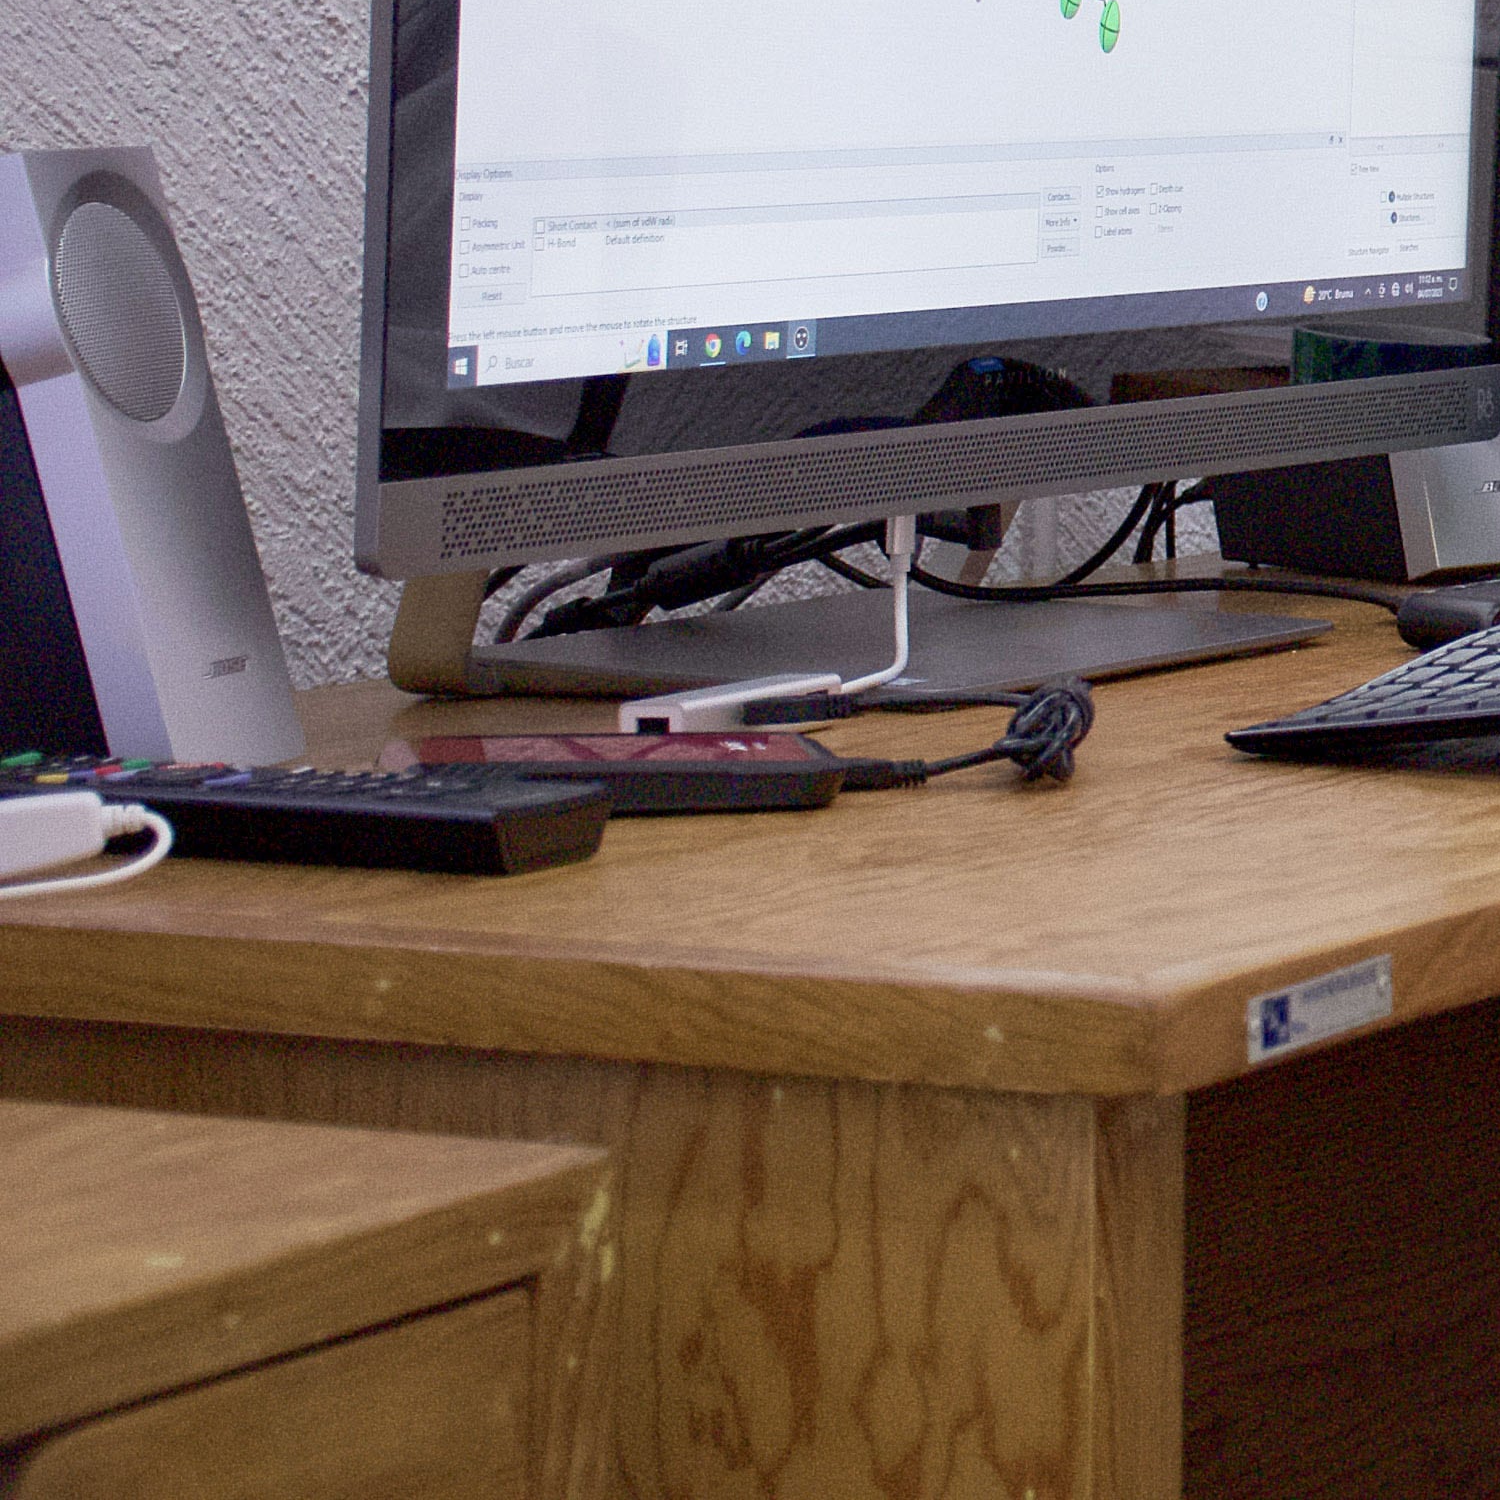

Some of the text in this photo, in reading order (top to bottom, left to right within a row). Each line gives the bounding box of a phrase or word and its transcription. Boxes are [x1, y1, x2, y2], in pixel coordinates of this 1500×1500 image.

[483, 167, 513, 182] Options
[472, 218, 499, 230] Packing
[547, 220, 568, 232] Short
[569, 218, 599, 231] Contact
[472, 241, 511, 253] Asymmetric
[547, 233, 665, 249] H-Bond Default definition
[481, 291, 503, 302] Reset
[469, 330, 481, 341] the
[483, 328, 496, 341] left
[497, 328, 521, 340] mouse
[523, 325, 548, 338] button
[549, 323, 563, 336] and
[564, 324, 585, 335] move
[586, 321, 598, 332] the
[599, 321, 623, 332] mouse
[504, 356, 535, 371] Buscar
